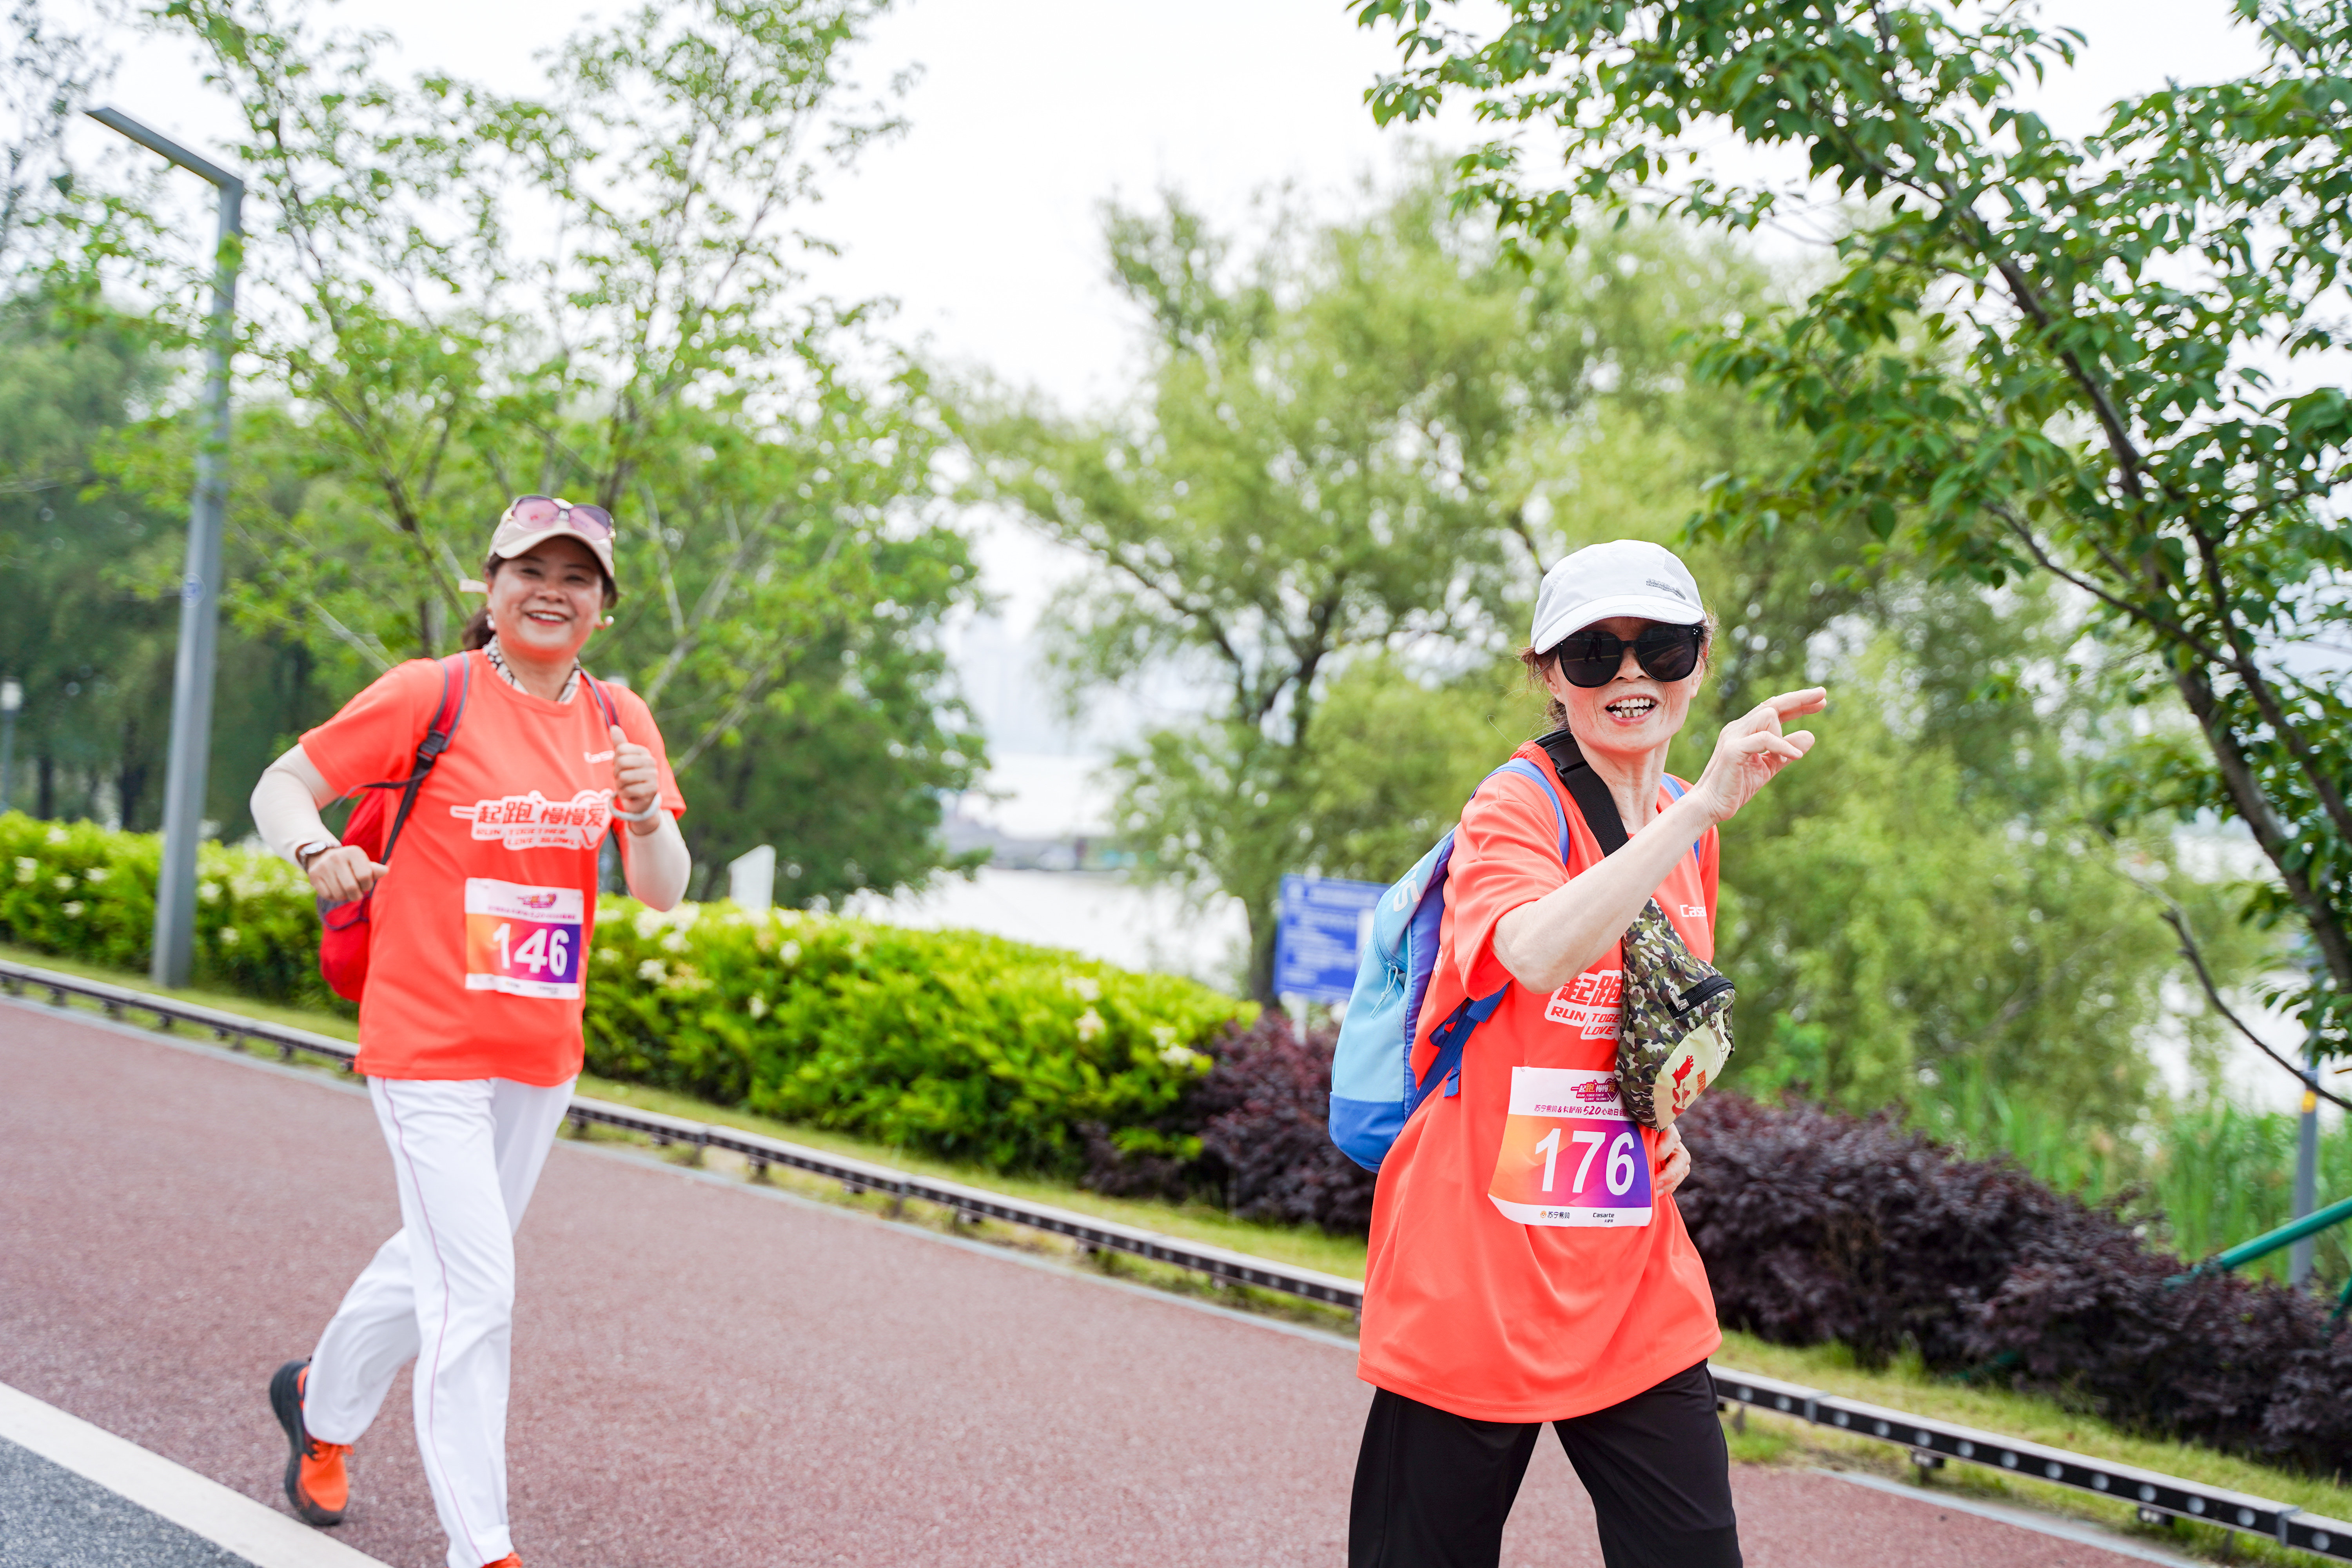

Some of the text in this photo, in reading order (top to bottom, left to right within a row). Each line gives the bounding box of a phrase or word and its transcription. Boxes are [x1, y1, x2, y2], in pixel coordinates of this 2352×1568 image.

[493, 923, 570, 976] 146
[1551, 1006, 1586, 1022] RUN
[1584, 1026, 1615, 1035] LOVE
[1535, 1128, 1635, 1196] 176
